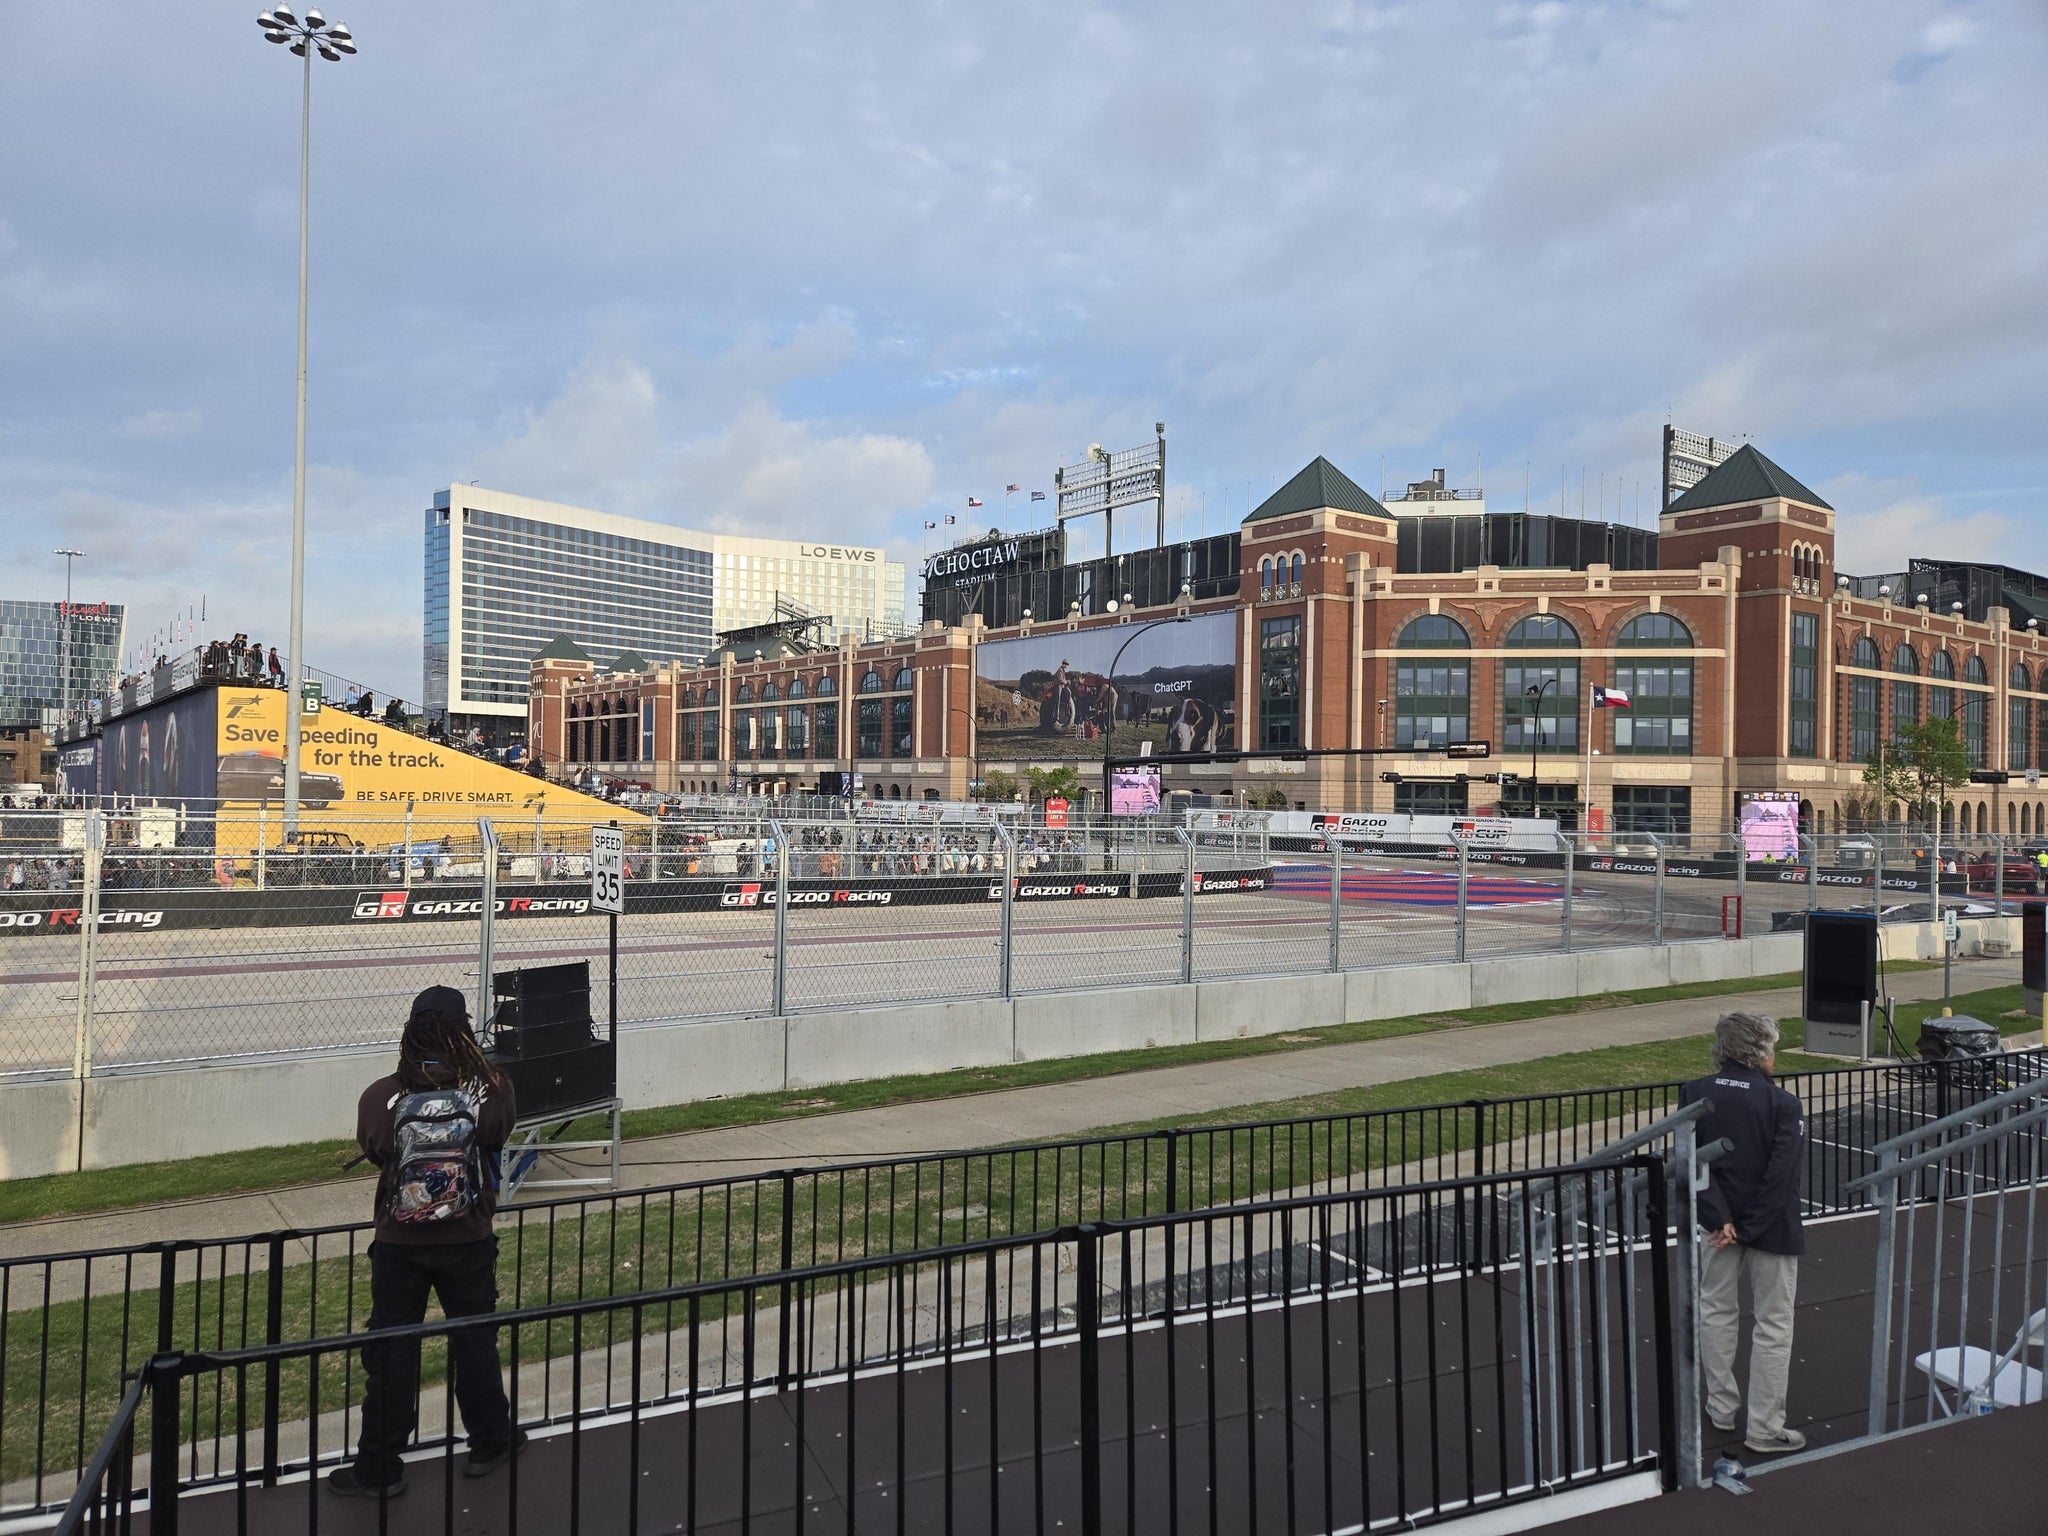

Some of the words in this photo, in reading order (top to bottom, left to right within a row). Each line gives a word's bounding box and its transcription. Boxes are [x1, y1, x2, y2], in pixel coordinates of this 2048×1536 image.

[801, 545, 876, 562] LOEWS
[934, 541, 1019, 577] CHOCTAW
[954, 572, 996, 587] STADIUM
[80, 615, 119, 624] LOEWS
[1154, 680, 1193, 694] ChatGPT
[306, 698, 319, 711] B
[225, 724, 279, 742] Save
[300, 728, 378, 749] peeding
[314, 748, 341, 766] for
[349, 750, 383, 767] the
[388, 751, 445, 768] track.
[356, 791, 376, 801] BE
[380, 791, 420, 802] SAFE.
[423, 792, 464, 802] DRIVE
[467, 792, 514, 803] SMART.
[1342, 817, 1388, 827] GAZOO
[1341, 826, 1386, 839] Racing
[1474, 827, 1509, 839] CUP
[594, 834, 622, 851] SPEED
[597, 854, 620, 869] LIMIT
[1492, 853, 1527, 865] Racing
[1590, 862, 1612, 871] GR
[1614, 863, 1657, 873] GAZOO
[1779, 871, 1806, 882] GR
[596, 870, 621, 904] 35
[1020, 885, 1072, 896] GAZOO
[1074, 883, 1119, 897] Racing
[1203, 879, 1239, 891] GAZOO
[1240, 877, 1265, 889] Racing
[722, 892, 757, 905] GR
[763, 891, 830, 904] GZOO
[833, 890, 892, 904] Racing
[355, 901, 403, 917] GR
[510, 897, 589, 914] Racing
[1729, 1079, 1751, 1090] SERVICES
